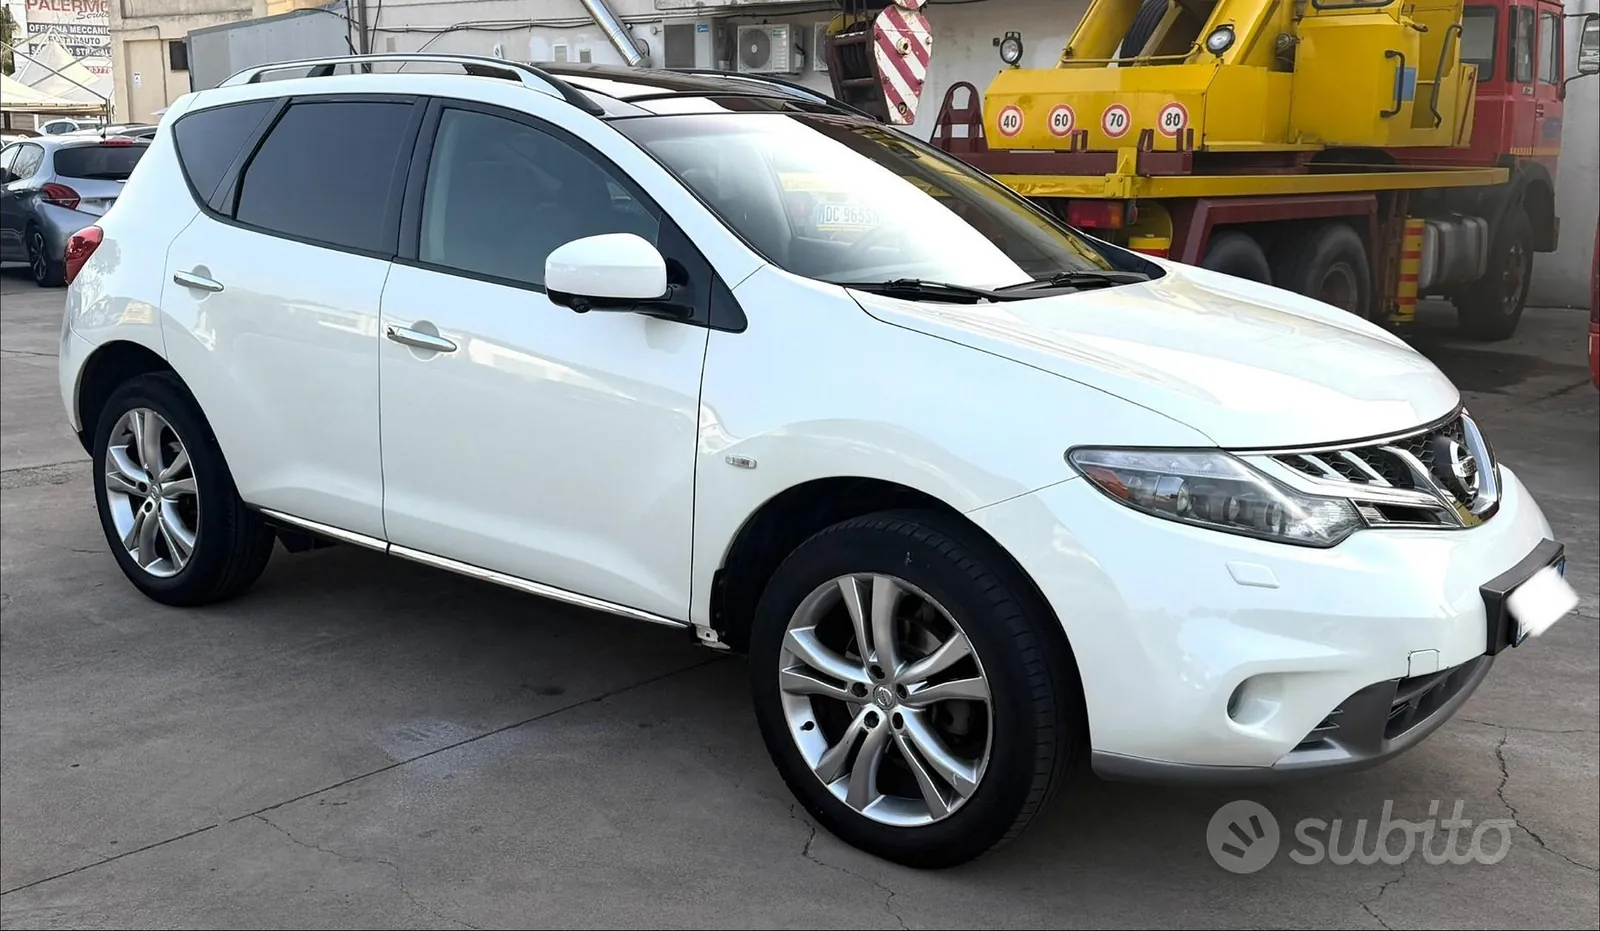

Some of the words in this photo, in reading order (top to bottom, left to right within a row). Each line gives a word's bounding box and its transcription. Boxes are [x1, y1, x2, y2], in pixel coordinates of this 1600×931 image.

[69, 26, 110, 35] MECCANIC
[1003, 114, 1017, 128] 40
[1054, 113, 1069, 128] 60
[1109, 113, 1124, 128] 70
[1165, 112, 1181, 127] 80
[826, 206, 840, 222] DC
